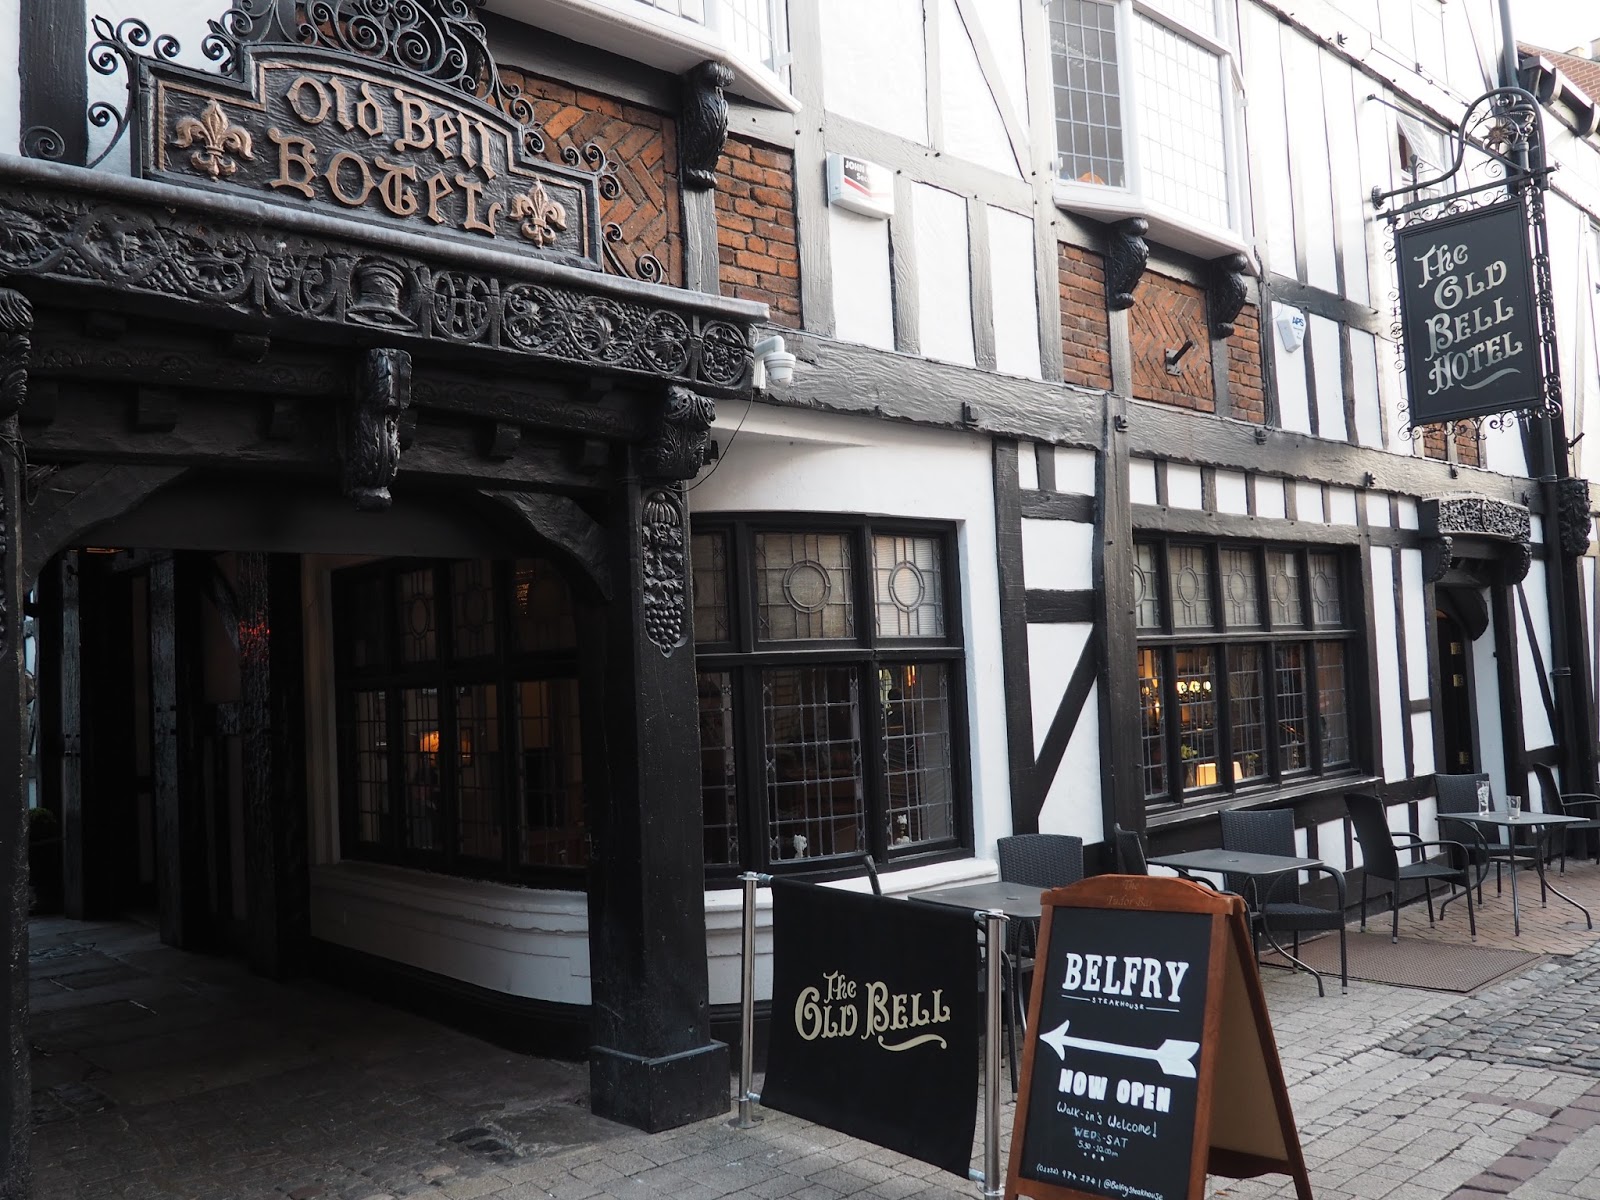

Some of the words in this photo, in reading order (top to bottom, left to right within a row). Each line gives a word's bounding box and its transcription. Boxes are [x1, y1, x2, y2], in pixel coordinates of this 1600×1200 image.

[286, 76, 384, 136] Old
[394, 89, 496, 180] Bell
[1413, 244, 1468, 288] The
[1424, 297, 1514, 361] BELL
[1427, 332, 1523, 395] HOTEL
[823, 970, 857, 1003] The
[1062, 953, 1189, 1002] BELFRY
[861, 981, 950, 1040] BELL
[1092, 997, 1145, 1011] STEAKHOUSE
[1058, 1068, 1108, 1101] NOW
[1116, 1079, 1171, 1113] OPEN
[1107, 1115, 1157, 1138] Welcome!
